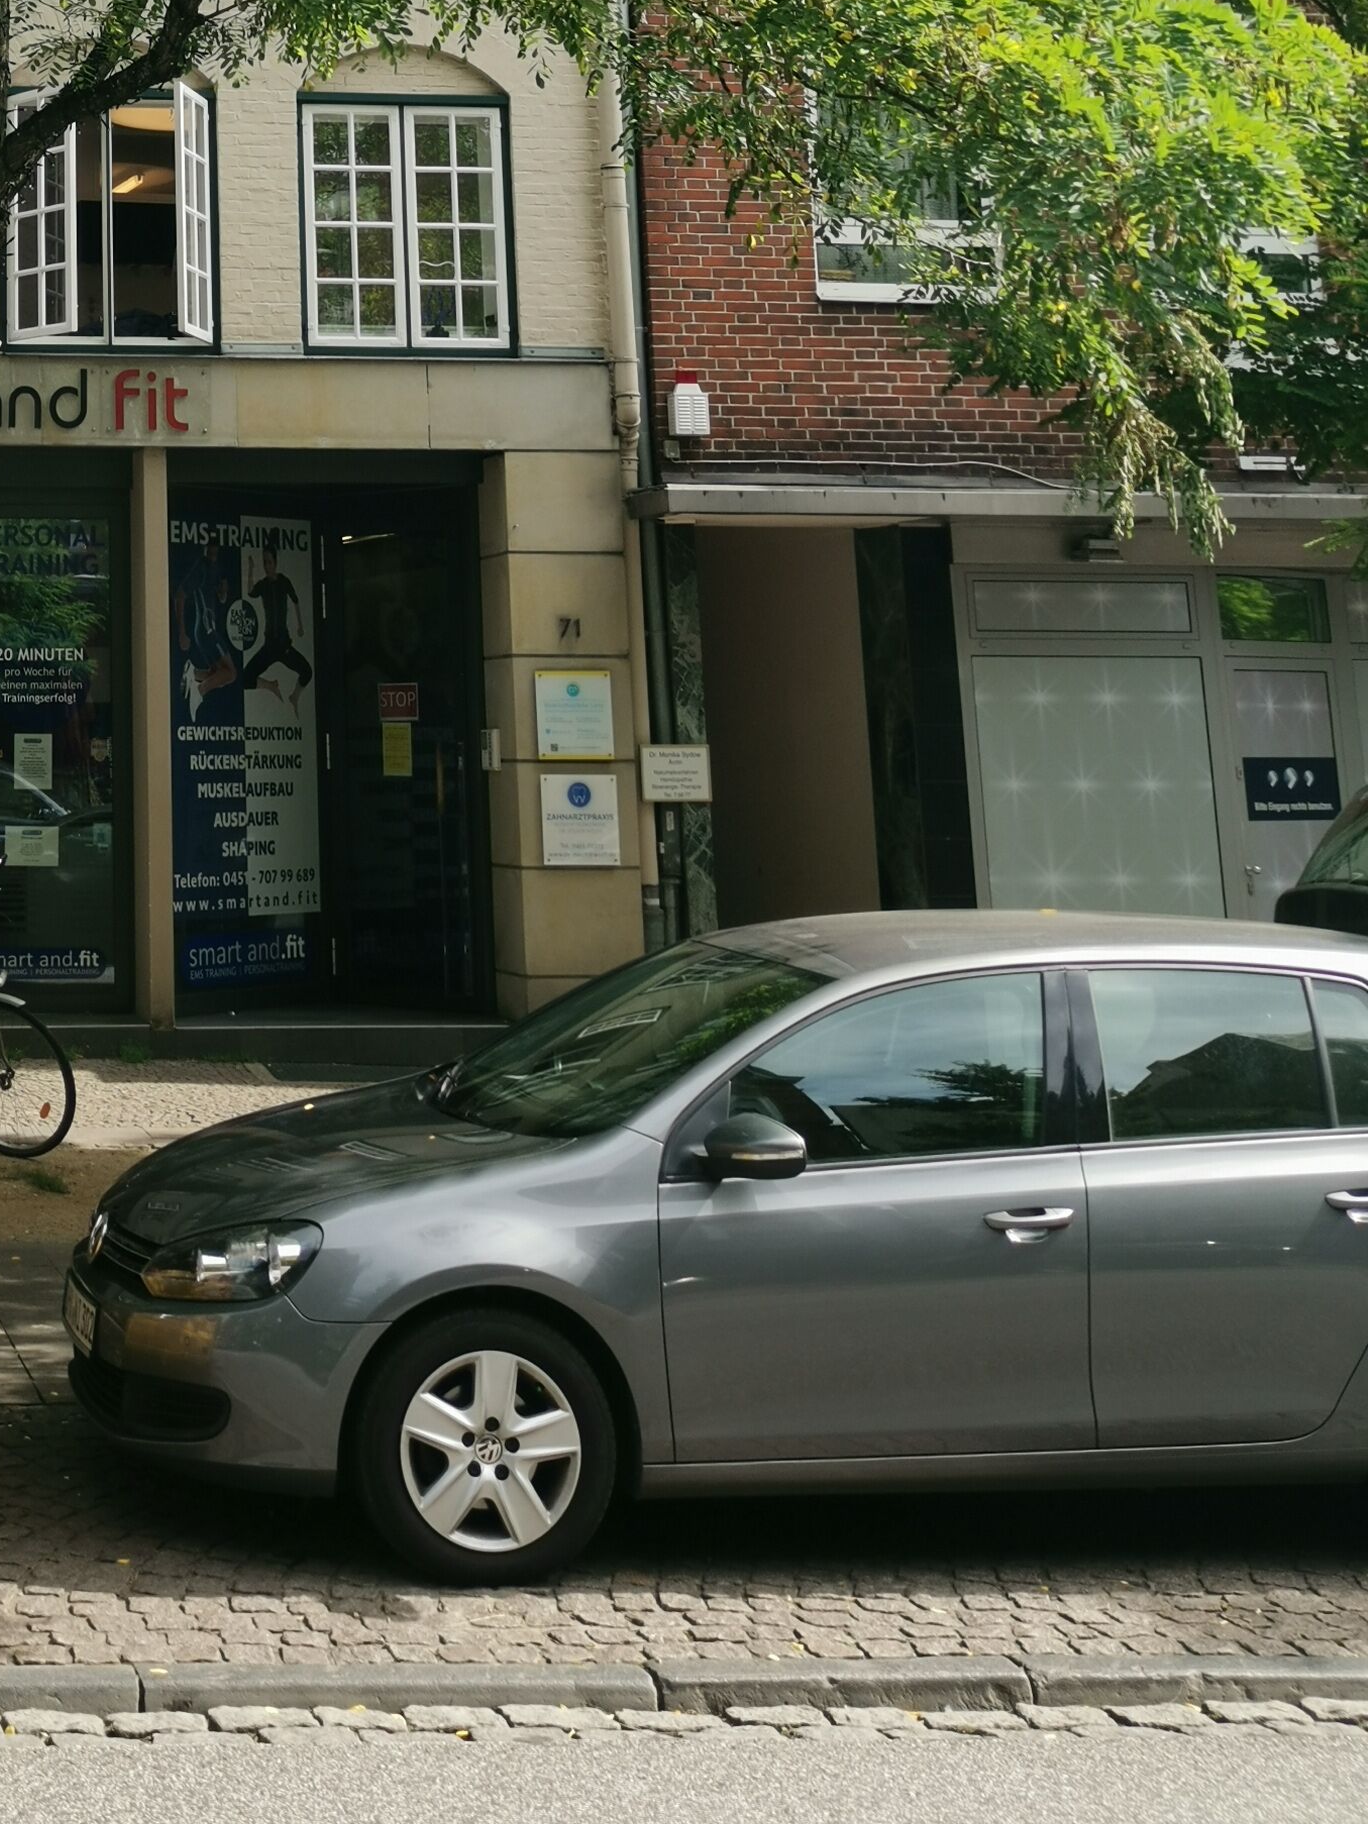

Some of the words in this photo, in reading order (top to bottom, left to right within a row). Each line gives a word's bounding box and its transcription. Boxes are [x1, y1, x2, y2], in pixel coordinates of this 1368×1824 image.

[112, 368, 190, 432] fit
[170, 520, 309, 552] EMS-TRAINING
[559, 617, 581, 639] 71
[17, 647, 84, 662] MINUTEN
[4, 668, 21, 679] pro
[23, 666, 56, 676] Woche
[58, 665, 72, 676] für
[30, 680, 83, 690] maximalen
[2, 693, 76, 705] Trainingserfolg!
[381, 691, 416, 708] STOP
[177, 726, 303, 741] GEWICHTSREDUKTION
[190, 750, 303, 770] RÜCKENSTÄRKUNG
[197, 782, 294, 798] MUSKELAUFBAU
[214, 811, 280, 828] AUSDAUER
[222, 839, 276, 857] SHAPING
[173, 872, 220, 889] Telefon:
[259, 870, 278, 884] 707
[280, 869, 293, 883] 99
[296, 868, 316, 882] 689
[189, 941, 243, 967] smart
